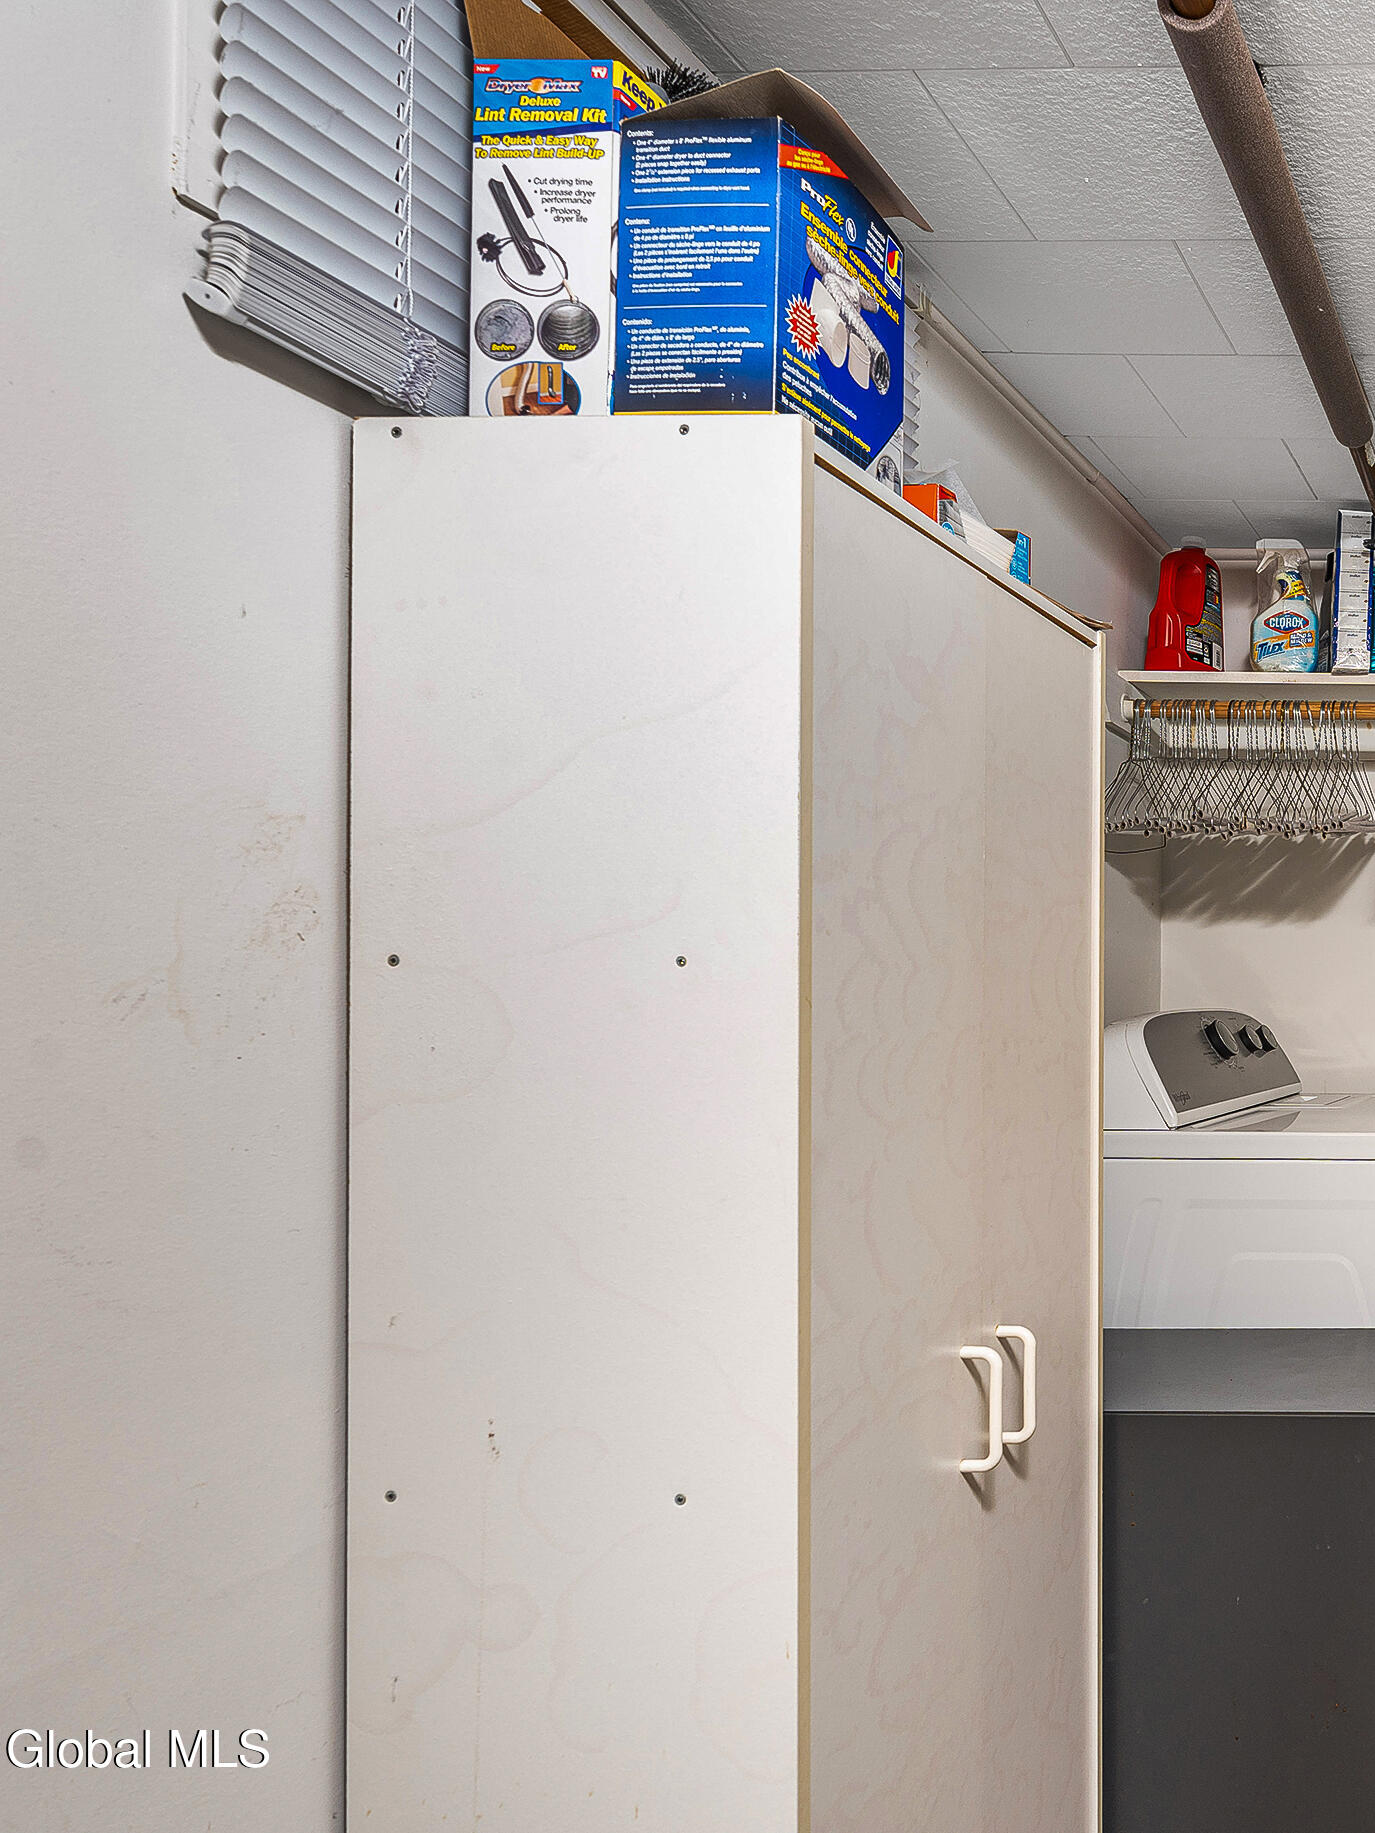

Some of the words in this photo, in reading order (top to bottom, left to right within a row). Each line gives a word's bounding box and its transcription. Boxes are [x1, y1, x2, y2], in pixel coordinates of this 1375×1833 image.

[592, 68, 607, 78] TV
[622, 70, 655, 111] Keep
[520, 95, 561, 106] Deluxe
[475, 108, 506, 121] Lint
[509, 108, 578, 121] Removal
[582, 108, 607, 123] Kit
[481, 136, 500, 145] The
[502, 135, 532, 146] Quick
[534, 136, 544, 145] &
[546, 136, 572, 147] Easy
[574, 136, 599, 148] Way
[475, 148, 488, 157] To
[489, 148, 531, 158] Remove
[534, 148, 555, 158] Lint
[533, 177, 548, 185] Cut
[549, 177, 573, 186] drying
[575, 178, 593, 186] time
[540, 188, 573, 196] Increase
[575, 189, 596, 198] dryer
[541, 196, 592, 205] performance
[801, 177, 844, 227] ProFlex
[550, 207, 581, 216] Prolong
[553, 215, 575, 223] dryer
[576, 215, 588, 223] life
[800, 201, 848, 254] Ensemble
[849, 249, 888, 298] connecteur
[806, 225, 859, 280] sèche-linge
[859, 273, 875, 297] vers
[875, 292, 900, 326] conduit
[491, 343, 516, 352] Before
[558, 343, 577, 352] After
[1269, 617, 1304, 629] CLOROX
[1257, 641, 1285, 660] TILEX
